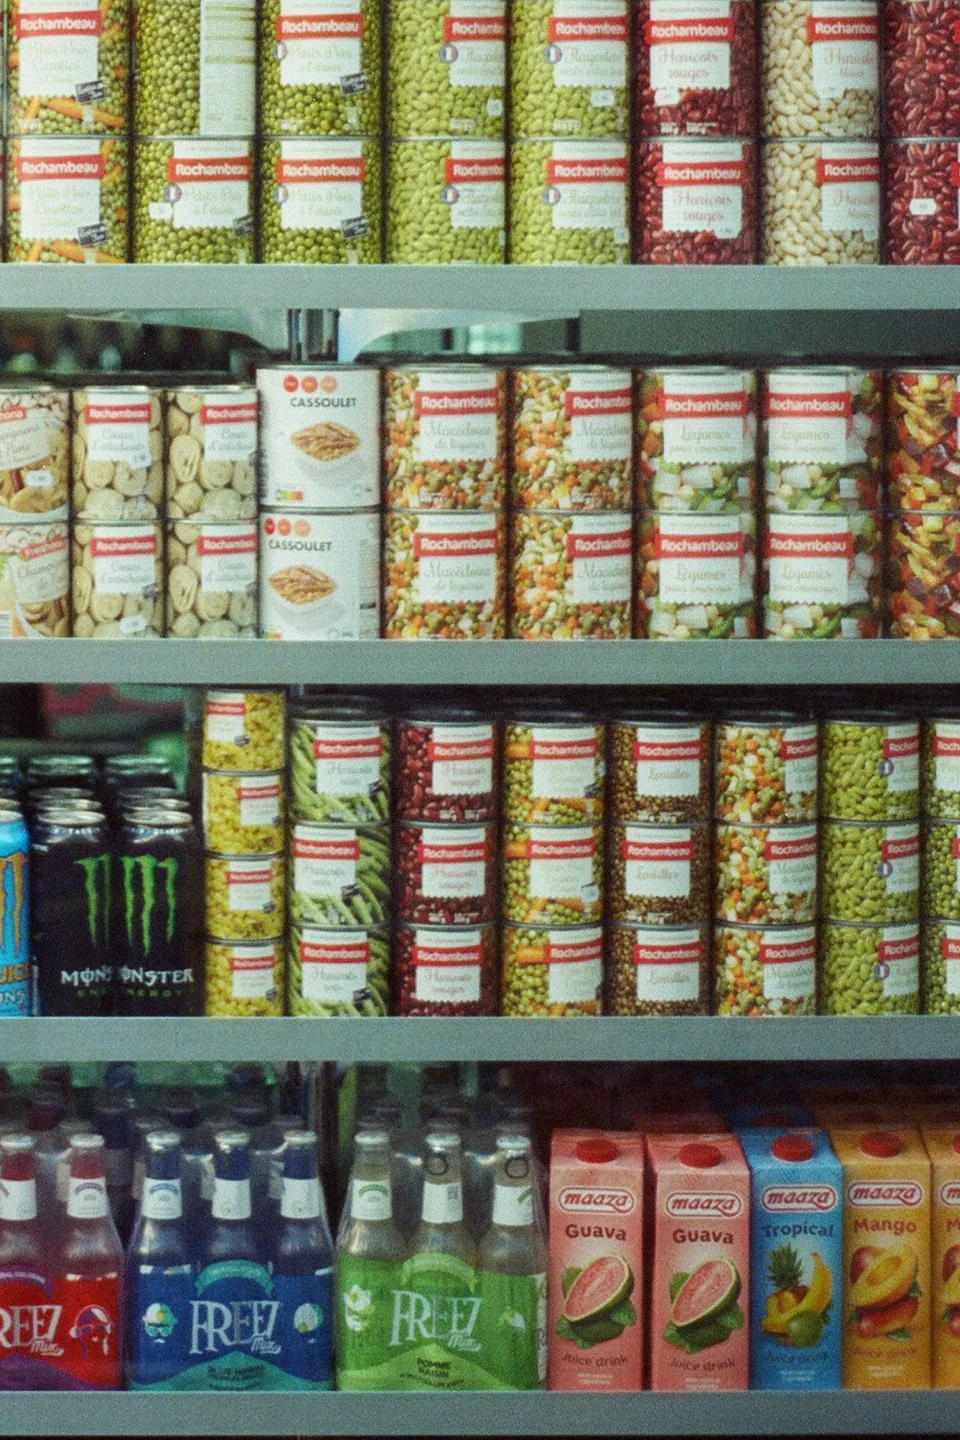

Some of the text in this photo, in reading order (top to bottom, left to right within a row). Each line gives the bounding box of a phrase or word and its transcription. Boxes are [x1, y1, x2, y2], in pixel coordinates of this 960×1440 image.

[21, 16, 96, 31] Rochambeau
[282, 19, 359, 34] Rochambeau
[651, 23, 729, 38] Rochambeau
[22, 160, 99, 176] Rochambeau
[283, 163, 360, 178] Rochambeau
[664, 166, 741, 181] Rochambeau
[289, 397, 356, 408] CASSOULET
[665, 398, 742, 413] Rochambeau
[770, 398, 845, 413] Rochambeau
[268, 540, 333, 553] CASSOULET
[661, 538, 739, 553] Rochambeau
[771, 539, 847, 554] Rochambeau
[765, 1189, 830, 1211] maaza
[853, 1184, 917, 1203] maaza
[564, 1193, 630, 1213] maaza
[671, 1198, 736, 1215] maaza
[565, 1223, 627, 1243] Guava
[762, 1220, 834, 1242] Tropical
[853, 1218, 917, 1236] Mango
[672, 1228, 734, 1245] Guava
[593, 1353, 629, 1369] drink
[702, 1356, 736, 1372] drink
